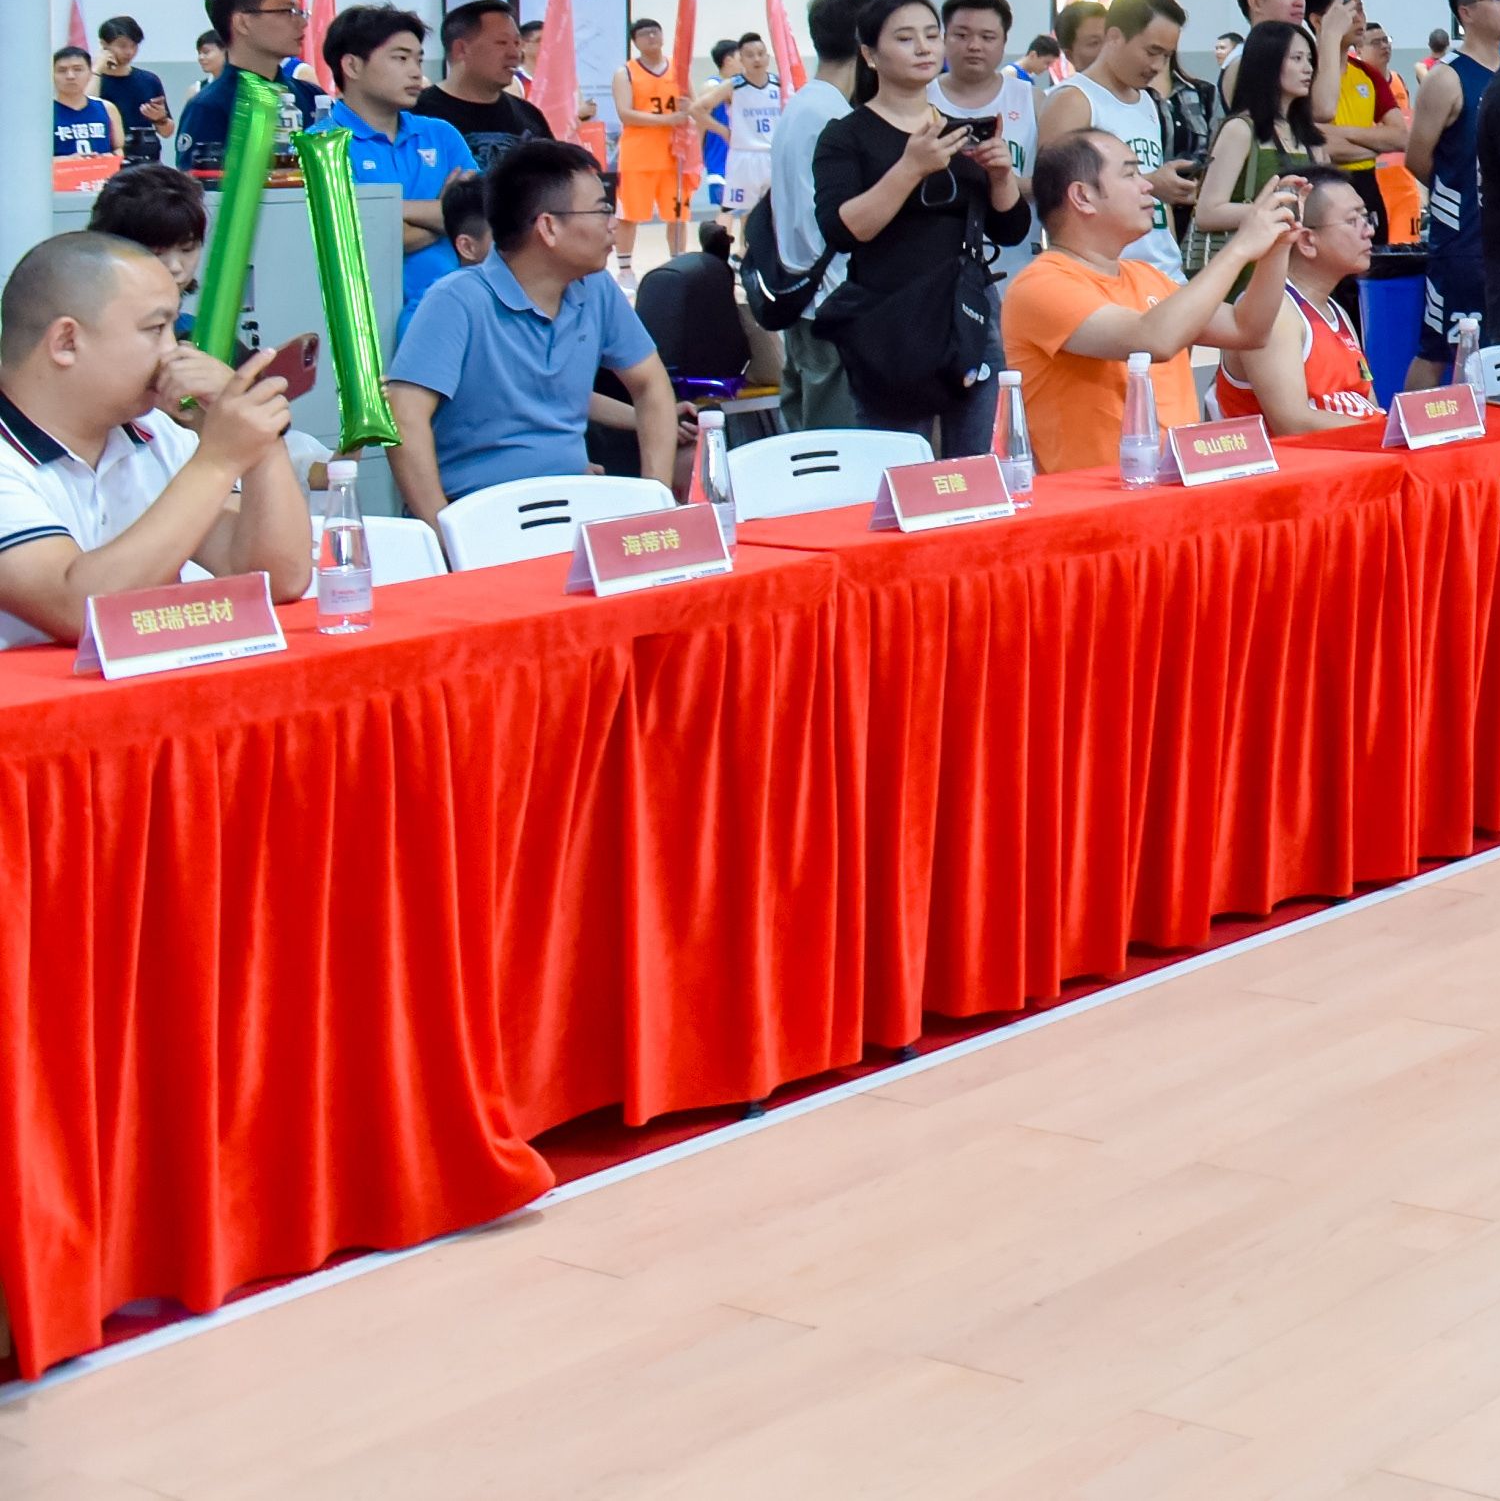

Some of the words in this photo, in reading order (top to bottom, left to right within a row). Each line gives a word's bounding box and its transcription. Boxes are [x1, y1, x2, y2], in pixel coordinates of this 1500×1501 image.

[756, 118, 771, 133] 16
[622, 528, 679, 556] 海蒂诗
[131, 598, 233, 635] 强瑞铝材
